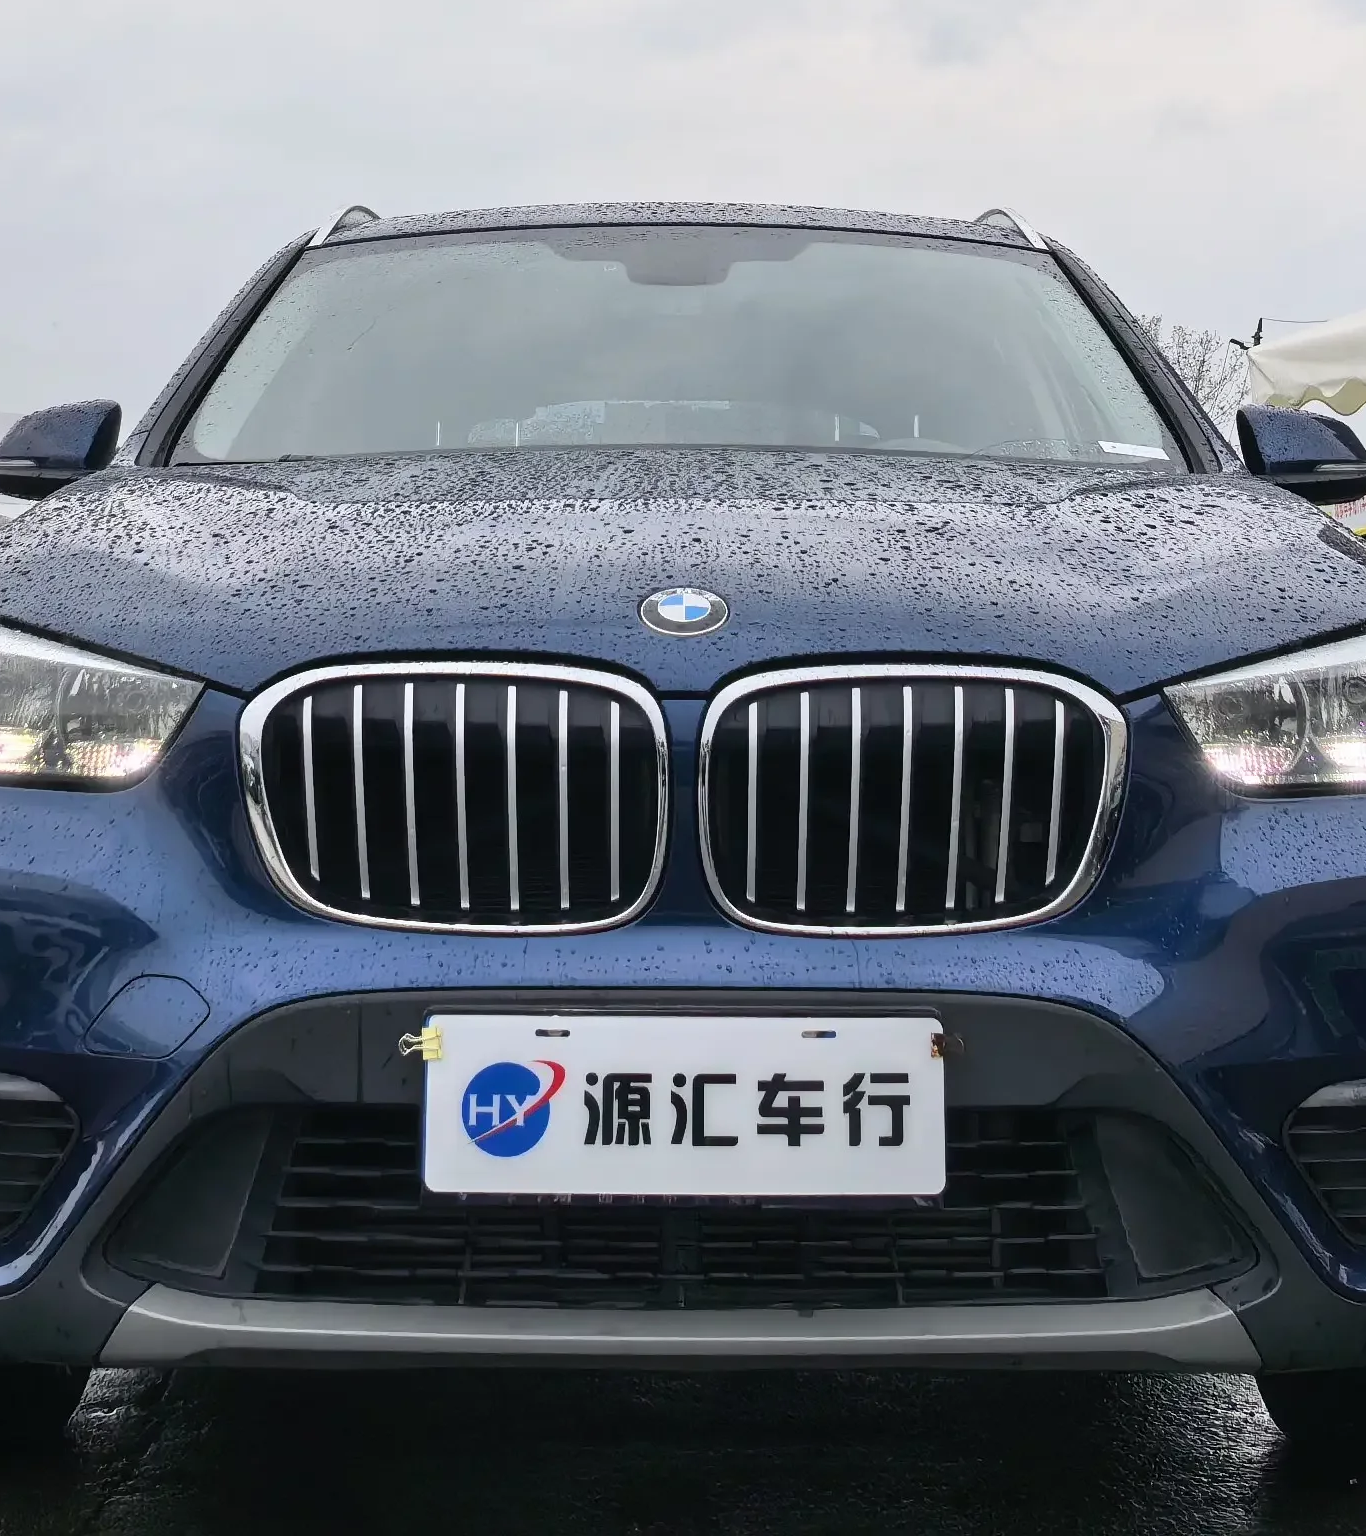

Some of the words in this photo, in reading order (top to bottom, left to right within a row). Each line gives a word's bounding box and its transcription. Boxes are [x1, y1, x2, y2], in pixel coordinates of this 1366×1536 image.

[468, 1092, 535, 1127] HY
[583, 1071, 912, 1148] 源汇车行
